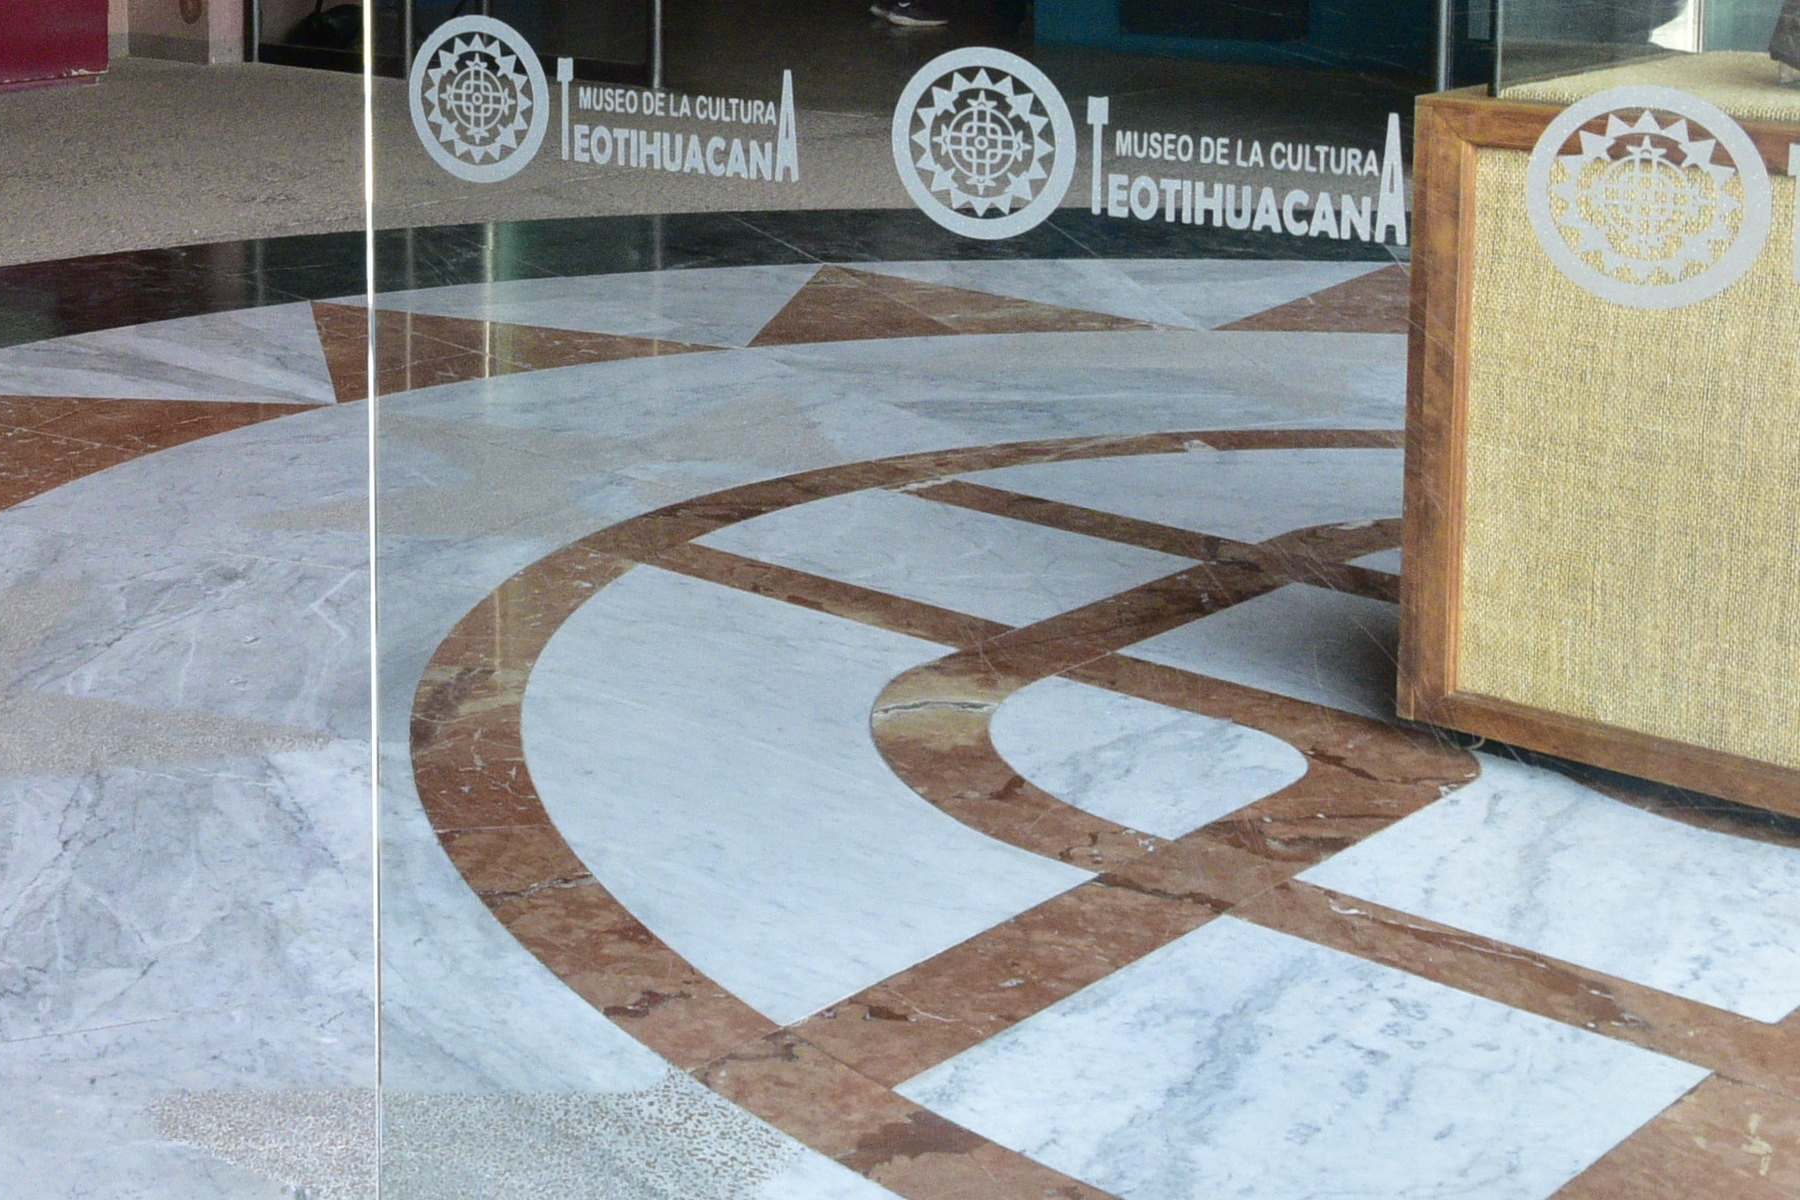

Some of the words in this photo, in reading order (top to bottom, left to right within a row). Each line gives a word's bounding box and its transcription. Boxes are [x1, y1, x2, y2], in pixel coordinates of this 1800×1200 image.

[579, 86, 638, 114] MUSEO
[642, 91, 666, 117] DE
[669, 94, 691, 118] LA
[695, 95, 777, 126] CULTURA
[1115, 130, 1194, 162] MUSEO
[1200, 136, 1230, 165] DE
[1236, 139, 1265, 168] LA
[1270, 142, 1379, 177] CULTURA
